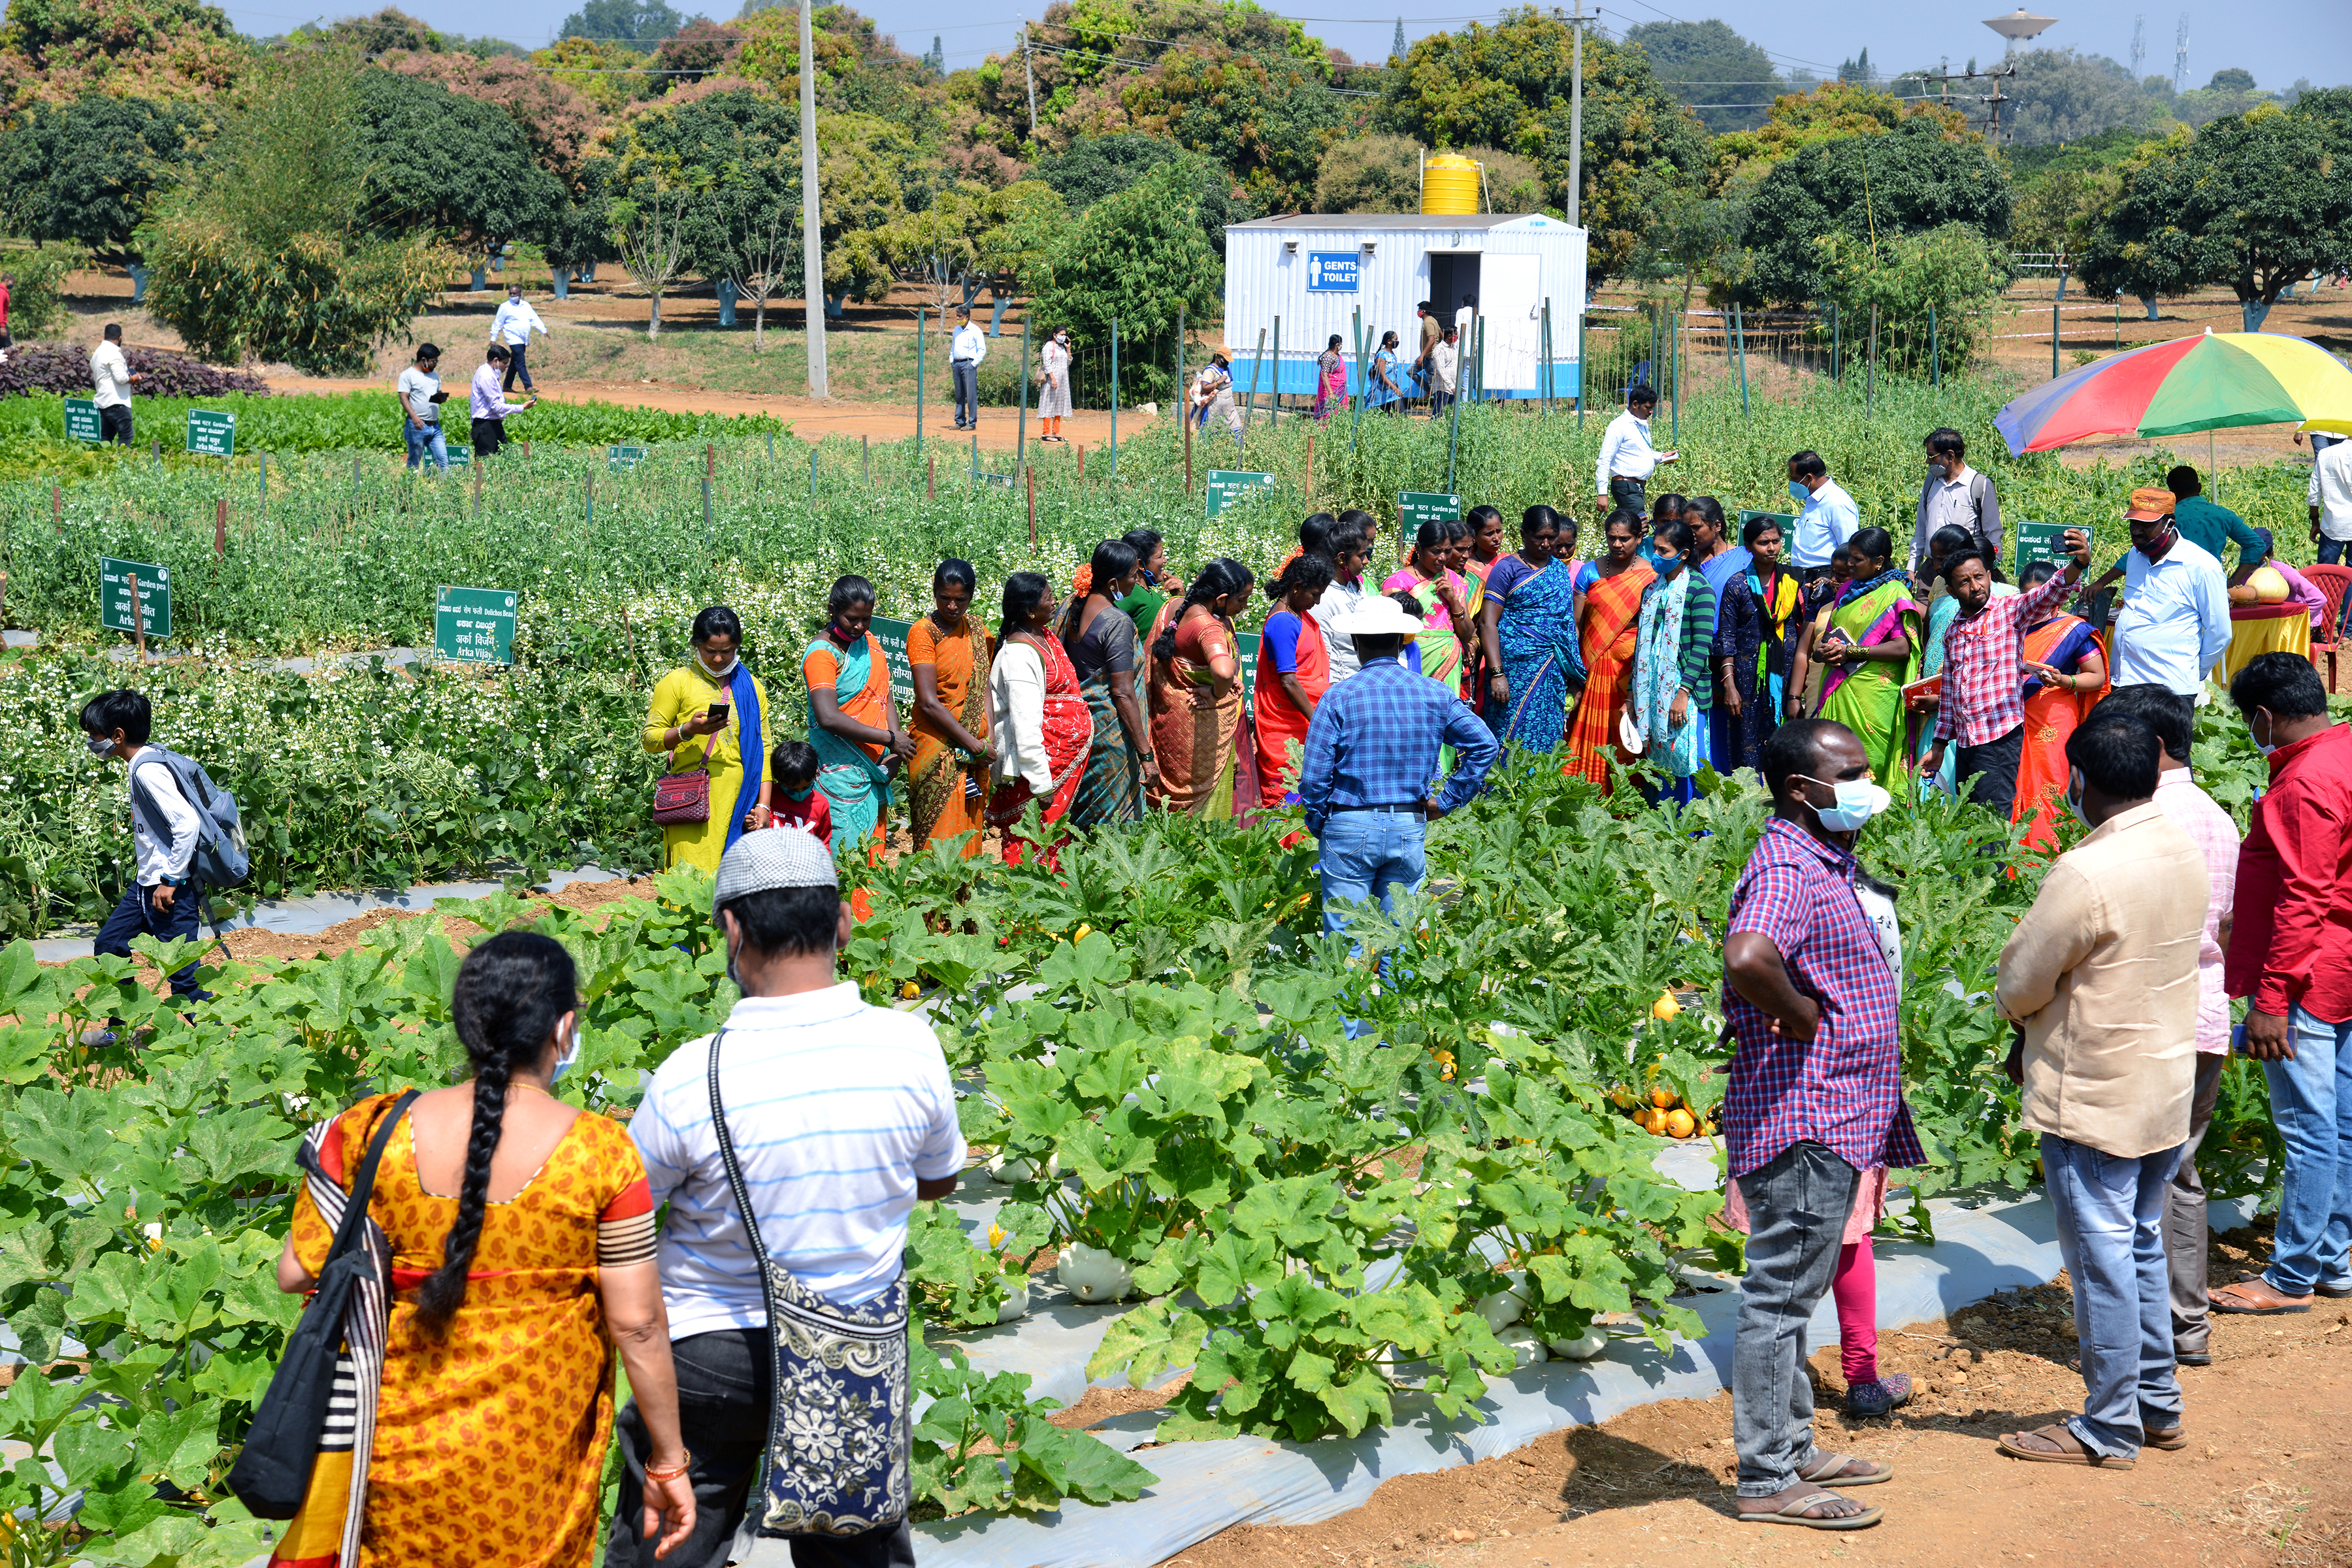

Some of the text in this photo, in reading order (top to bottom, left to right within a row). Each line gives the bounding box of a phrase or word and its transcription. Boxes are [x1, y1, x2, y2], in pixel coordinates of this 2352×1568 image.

[1324, 261, 1356, 270] GENTS
[1323, 273, 1357, 282] TOILET
[208, 444, 225, 453] Mayur
[138, 578, 155, 589] Garden
[115, 601, 155, 617] अर्का जीत
[473, 606, 482, 615] फली
[484, 608, 502, 617] Dolichos
[119, 614, 135, 626] Arka
[455, 632, 472, 644] अर्का
[890, 636, 900, 648] फली
[457, 646, 492, 660] Arka Vijay
[892, 665, 911, 681] सौम्या
